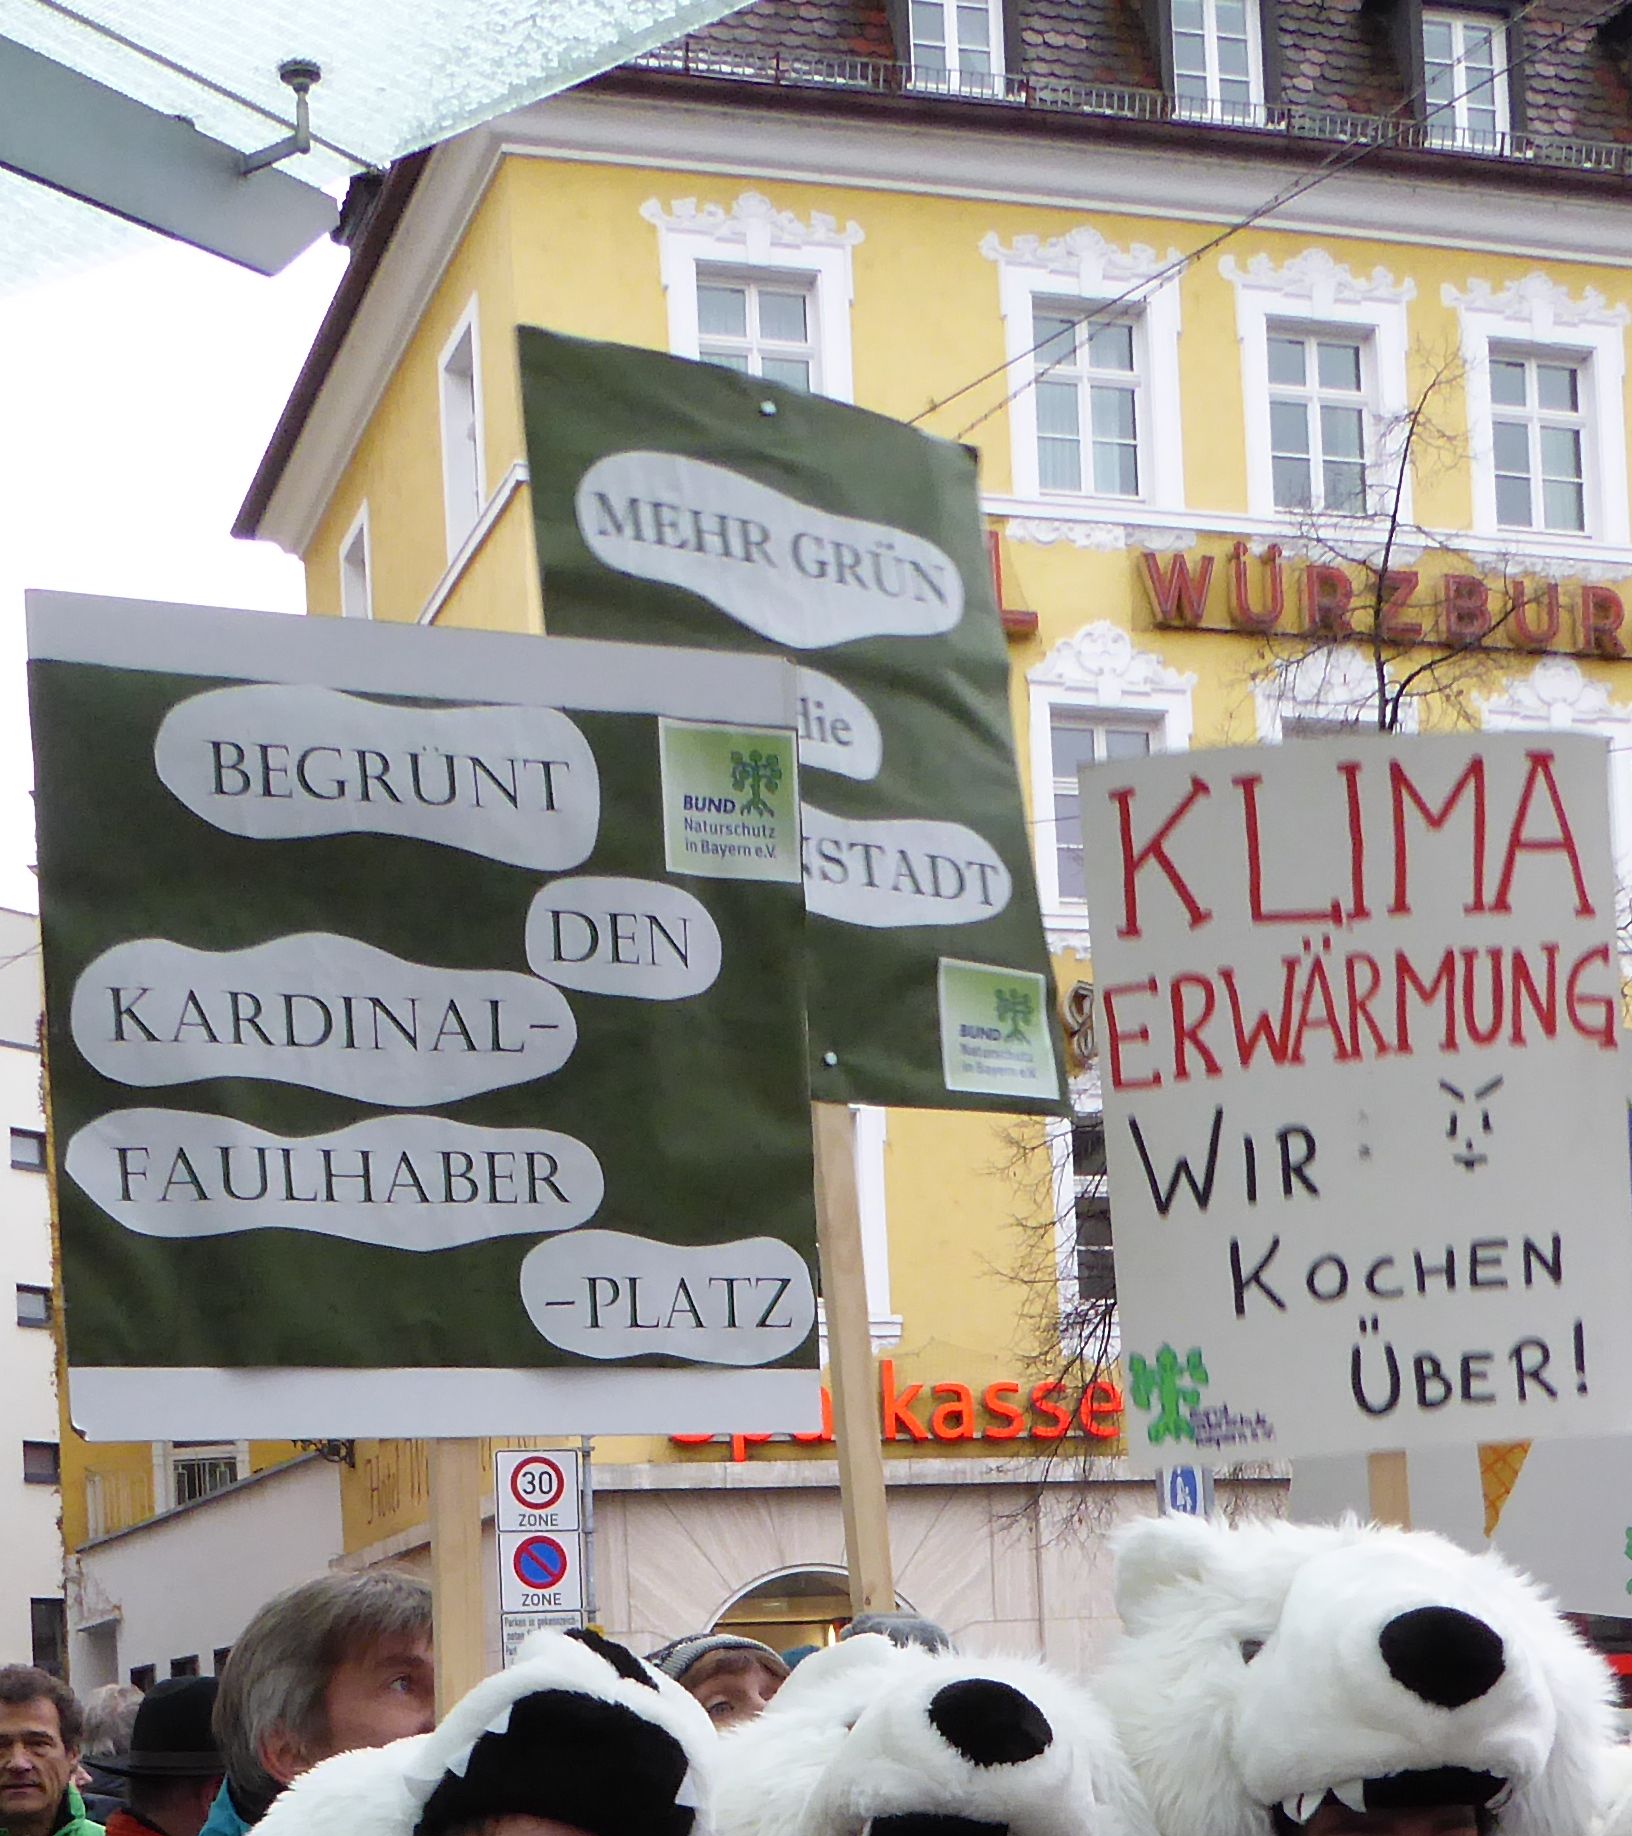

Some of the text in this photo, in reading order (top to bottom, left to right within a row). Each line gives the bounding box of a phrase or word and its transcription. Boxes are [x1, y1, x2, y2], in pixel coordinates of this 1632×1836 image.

[593, 492, 949, 606] MEHR GRÜN
[210, 740, 570, 812] BEGRÜNT
[683, 794, 736, 814] BUND
[684, 816, 776, 838] Naturschutz
[685, 838, 698, 853] in
[701, 838, 752, 858] Bayern
[1108, 747, 1598, 939] KLIMA
[549, 910, 691, 971] DEN
[107, 985, 559, 1054] KARDINAL-
[1103, 932, 1618, 1092] ERWÄRMUNG
[115, 1145, 570, 1204] FAULHABER
[1128, 1104, 1320, 1216] WIR
[544, 1276, 794, 1330] -PLATZ
[1228, 1230, 1564, 1318] KOCHEN
[1350, 1314, 1588, 1418] ÜBER!
[522, 1471, 553, 1495] 30
[518, 1513, 559, 1527] ZONE
[522, 1593, 562, 1607] ZONE
